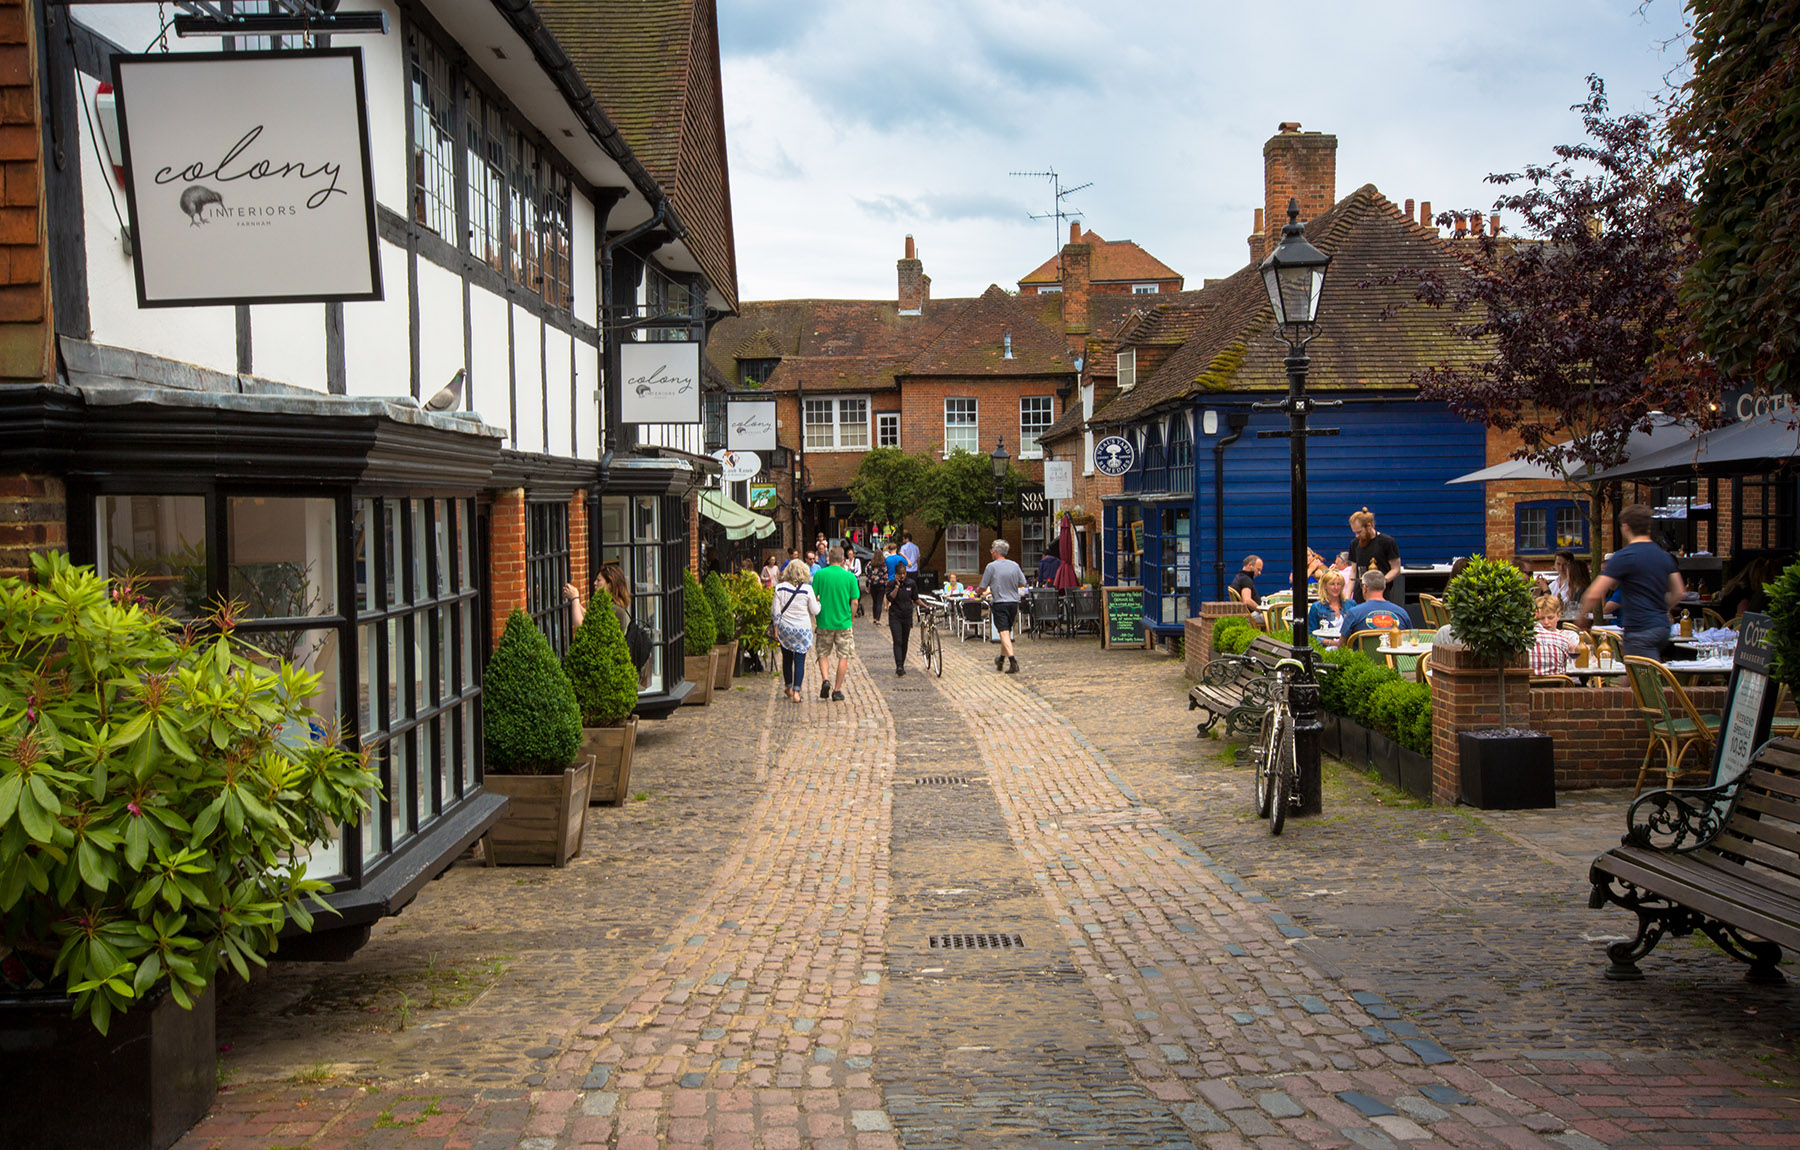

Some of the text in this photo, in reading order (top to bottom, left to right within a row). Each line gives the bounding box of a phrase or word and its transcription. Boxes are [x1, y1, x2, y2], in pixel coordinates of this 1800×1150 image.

[154, 125, 348, 210] colony
[209, 205, 297, 218] INTERIORS
[627, 364, 693, 394] colony
[731, 414, 772, 434] colony
[1116, 439, 1131, 455] YARD
[1098, 459, 1131, 474] REMEDIES
[1021, 492, 1043, 502] NOA
[1021, 501, 1044, 512] NOA
[1740, 651, 1766, 666] BRASSERIE
[1733, 722, 1752, 739] SPECIALS
[1730, 736, 1748, 758] 10.95
